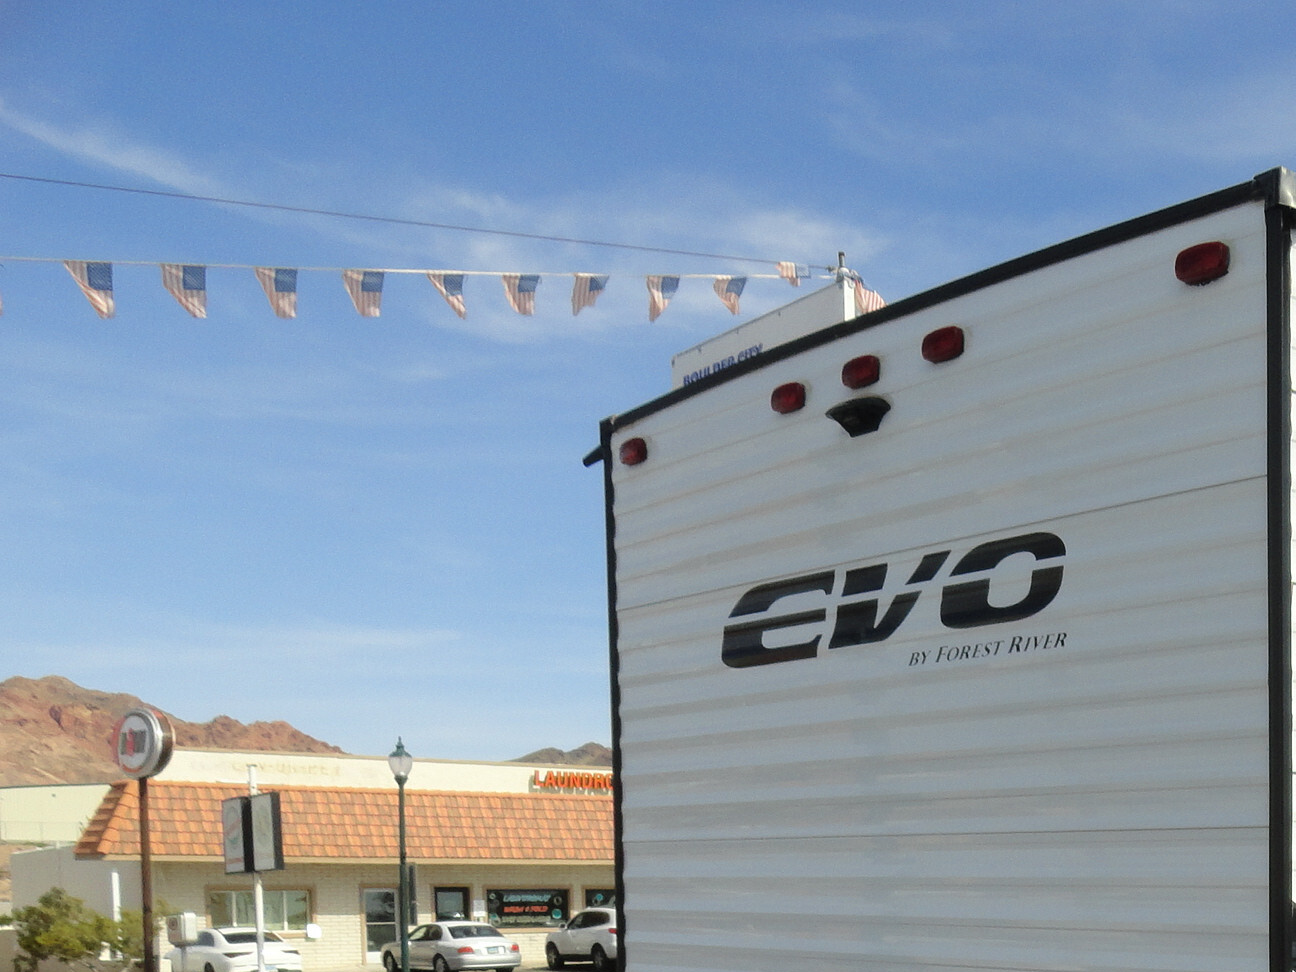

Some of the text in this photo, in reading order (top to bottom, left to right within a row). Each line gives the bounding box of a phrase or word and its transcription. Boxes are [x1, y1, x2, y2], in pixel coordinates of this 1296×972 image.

[683, 343, 763, 386] BOULDER CITY
[721, 532, 1066, 669] EVO
[908, 632, 1068, 667] BY FOREST RIVER
